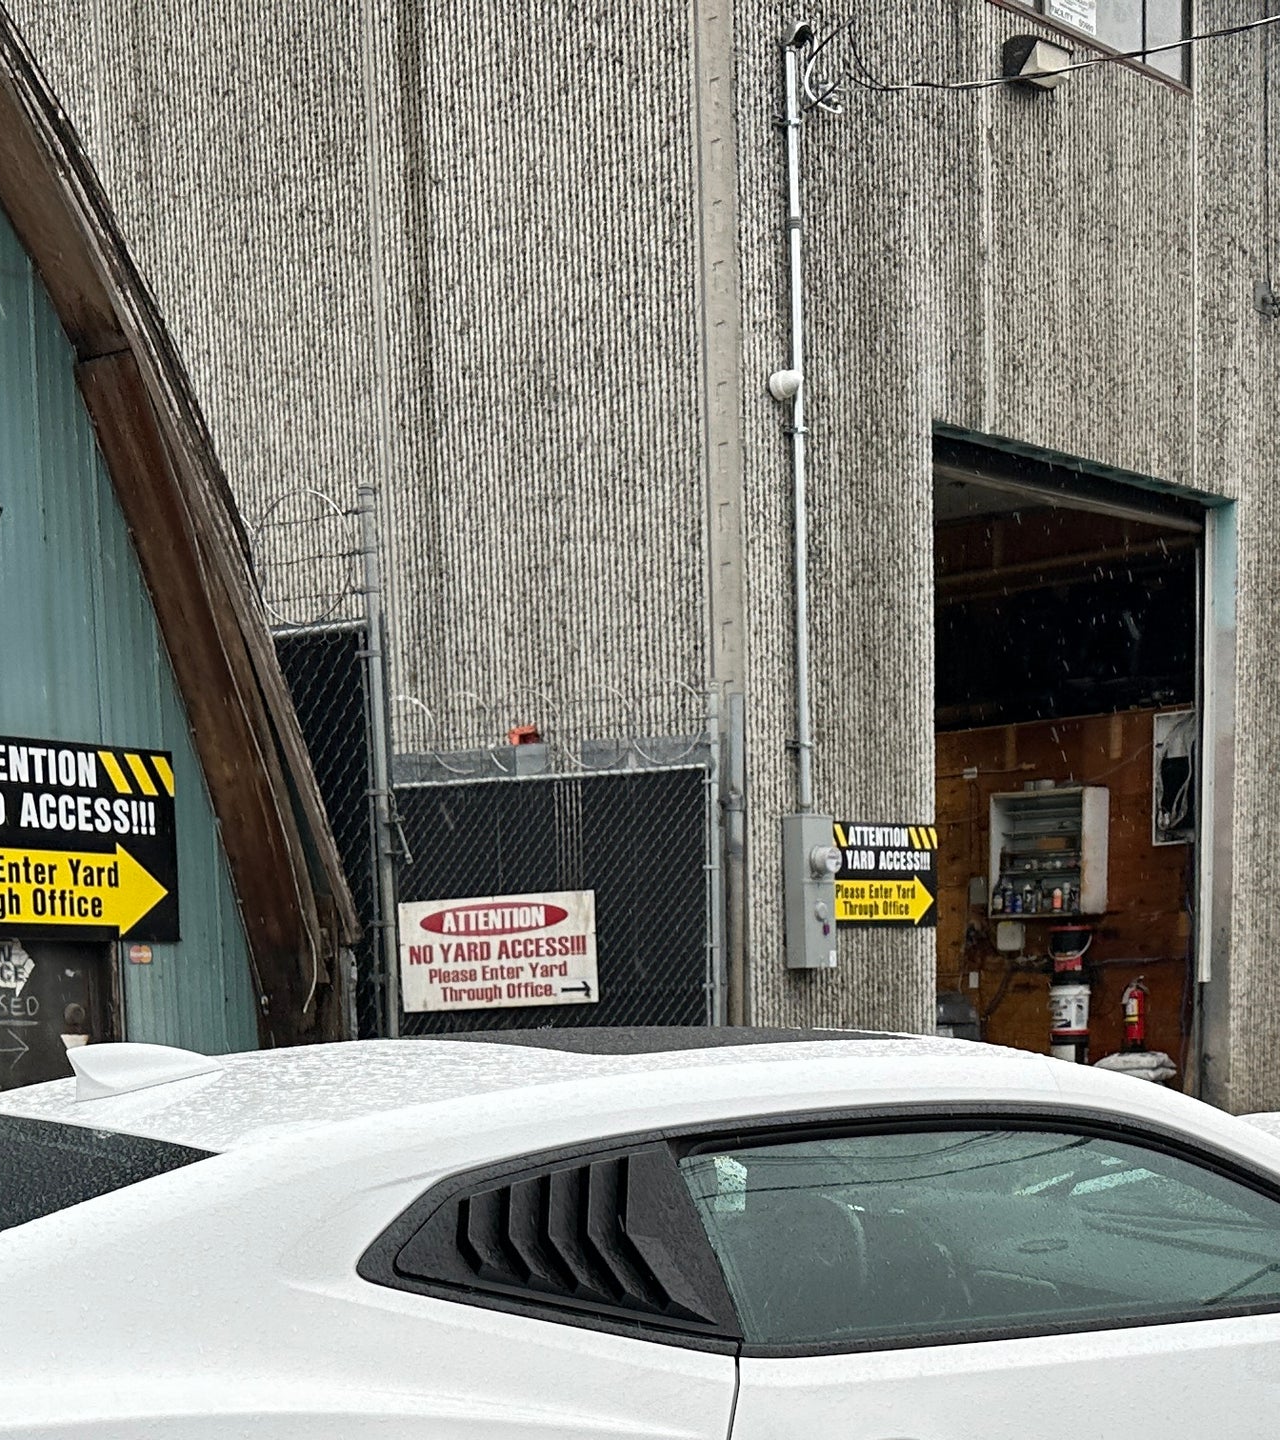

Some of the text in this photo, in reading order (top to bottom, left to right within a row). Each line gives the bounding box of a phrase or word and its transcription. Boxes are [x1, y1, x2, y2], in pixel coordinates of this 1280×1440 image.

[19, 793, 157, 835] ACCESS!!!
[848, 826, 909, 848] ATTENTION
[846, 850, 931, 871] YARD ACCESS!!!
[68, 858, 120, 888] Yard
[32, 888, 104, 918] Office
[835, 884, 916, 899] Please Enter Yard
[442, 905, 546, 934] ATTENTION
[843, 901, 910, 918] Through Office
[409, 935, 587, 965] NO YARD ACCESS!!!
[428, 961, 568, 985] Please Enter Yard
[440, 985, 502, 1003] Through
